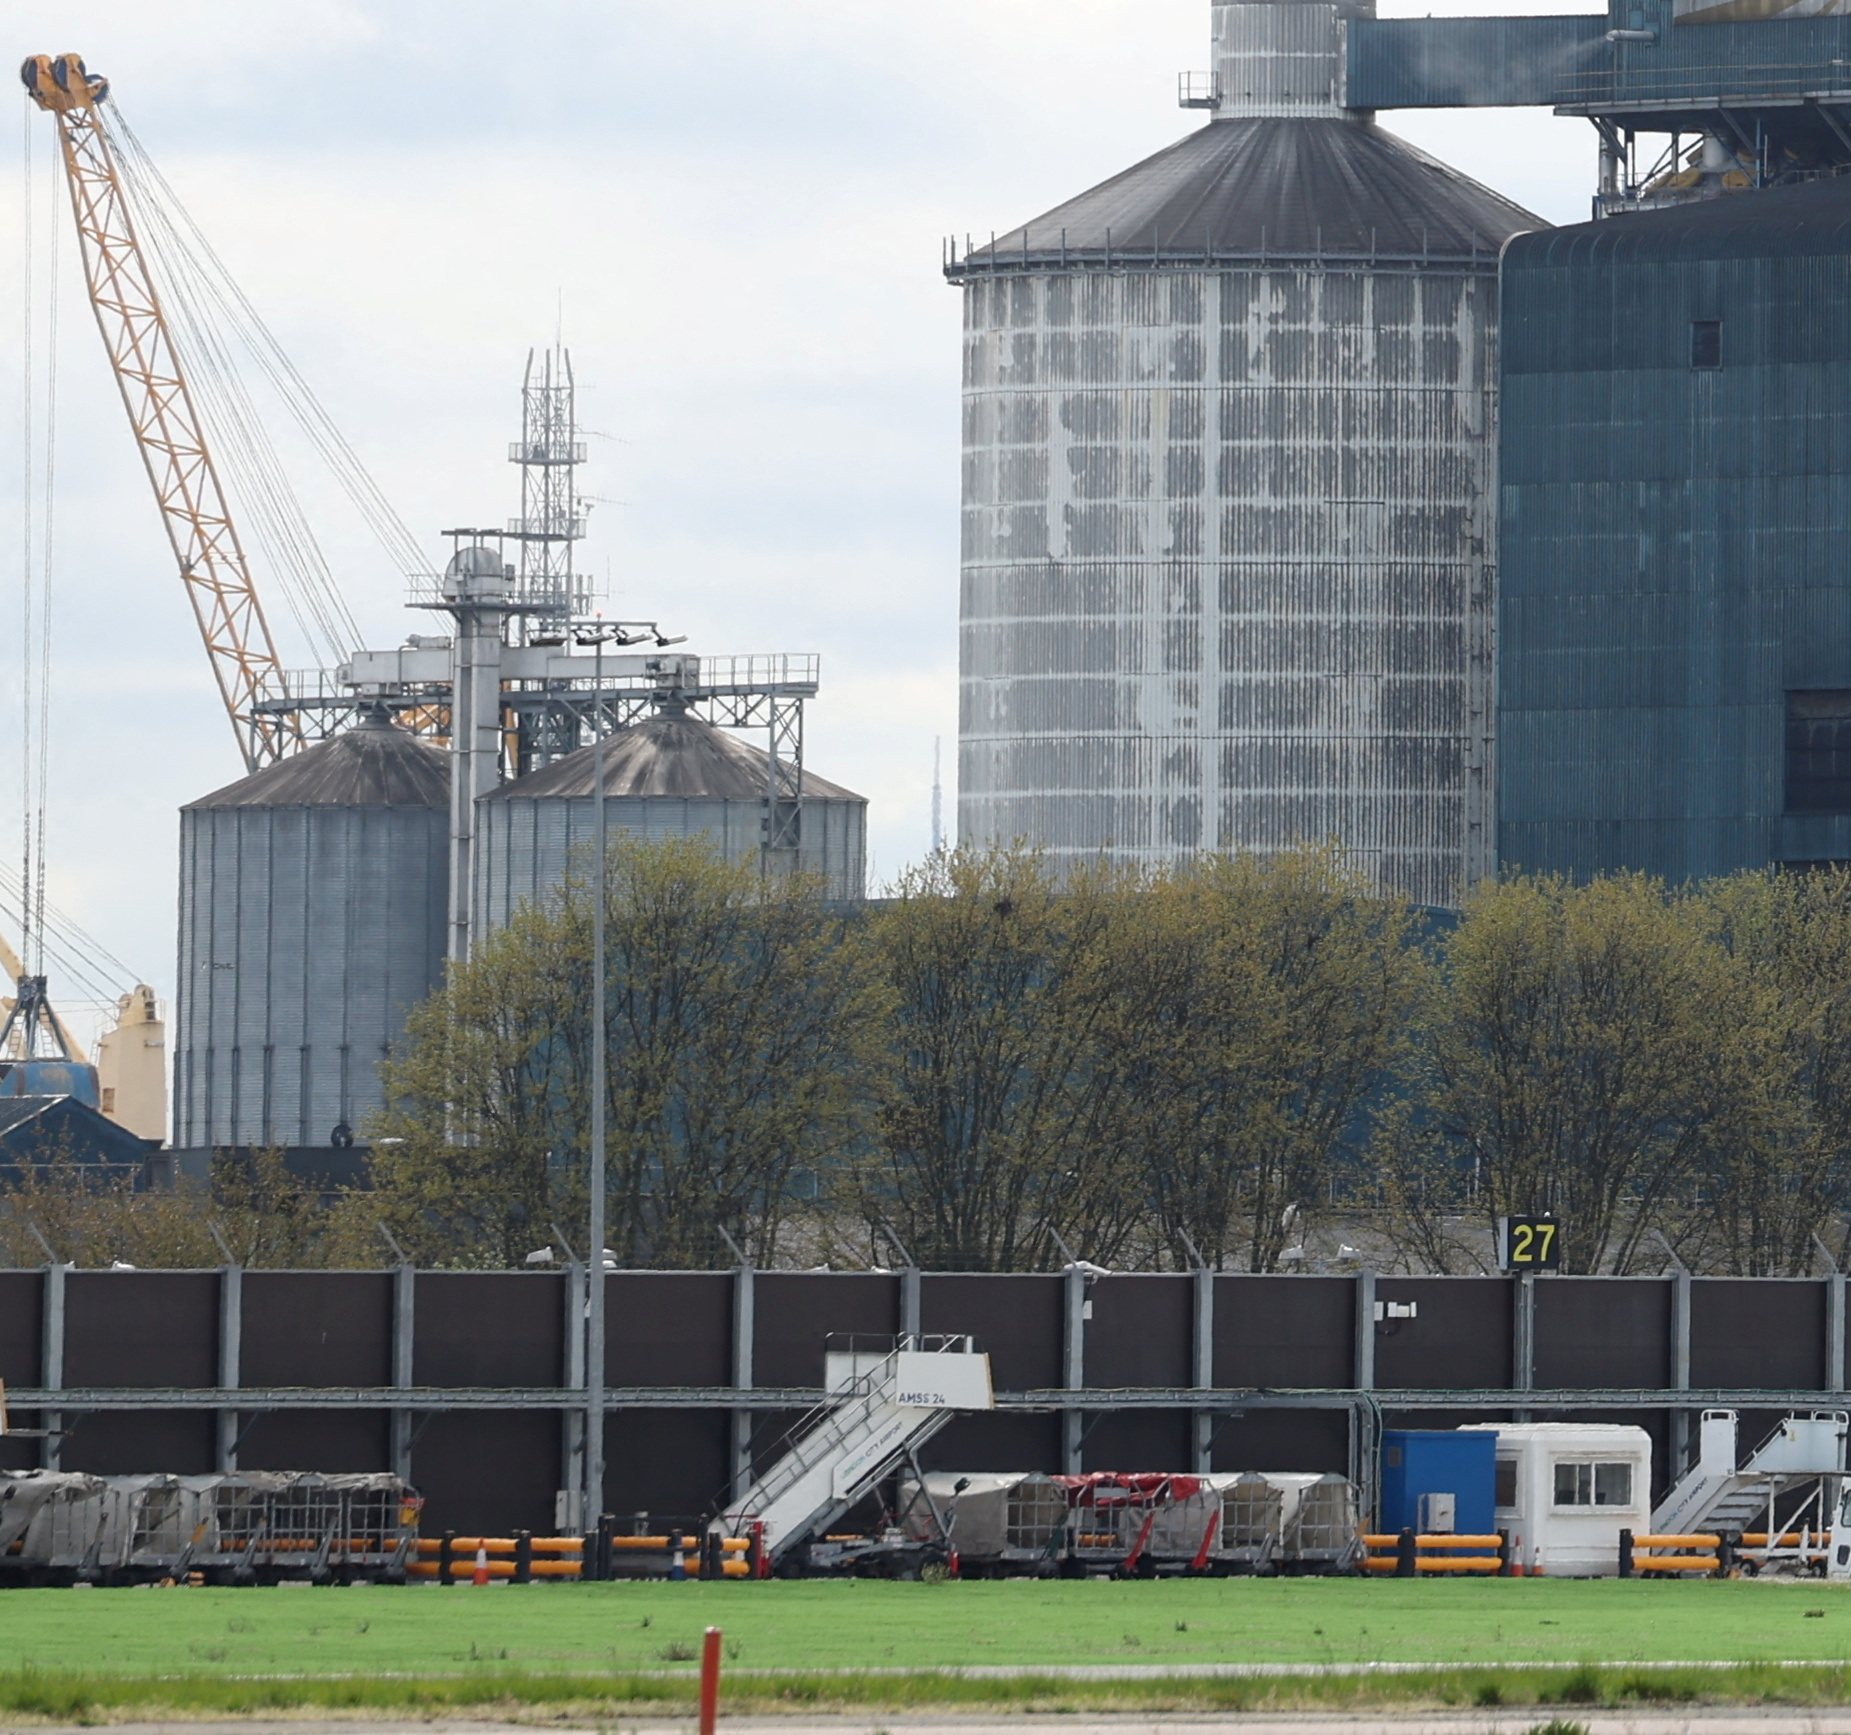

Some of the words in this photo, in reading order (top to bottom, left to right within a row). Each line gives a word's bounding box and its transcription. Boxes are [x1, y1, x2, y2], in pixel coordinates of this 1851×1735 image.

[1513, 1224, 1555, 1262] 27
[899, 1392, 930, 1404] AMSS
[933, 1394, 945, 1404] 24
